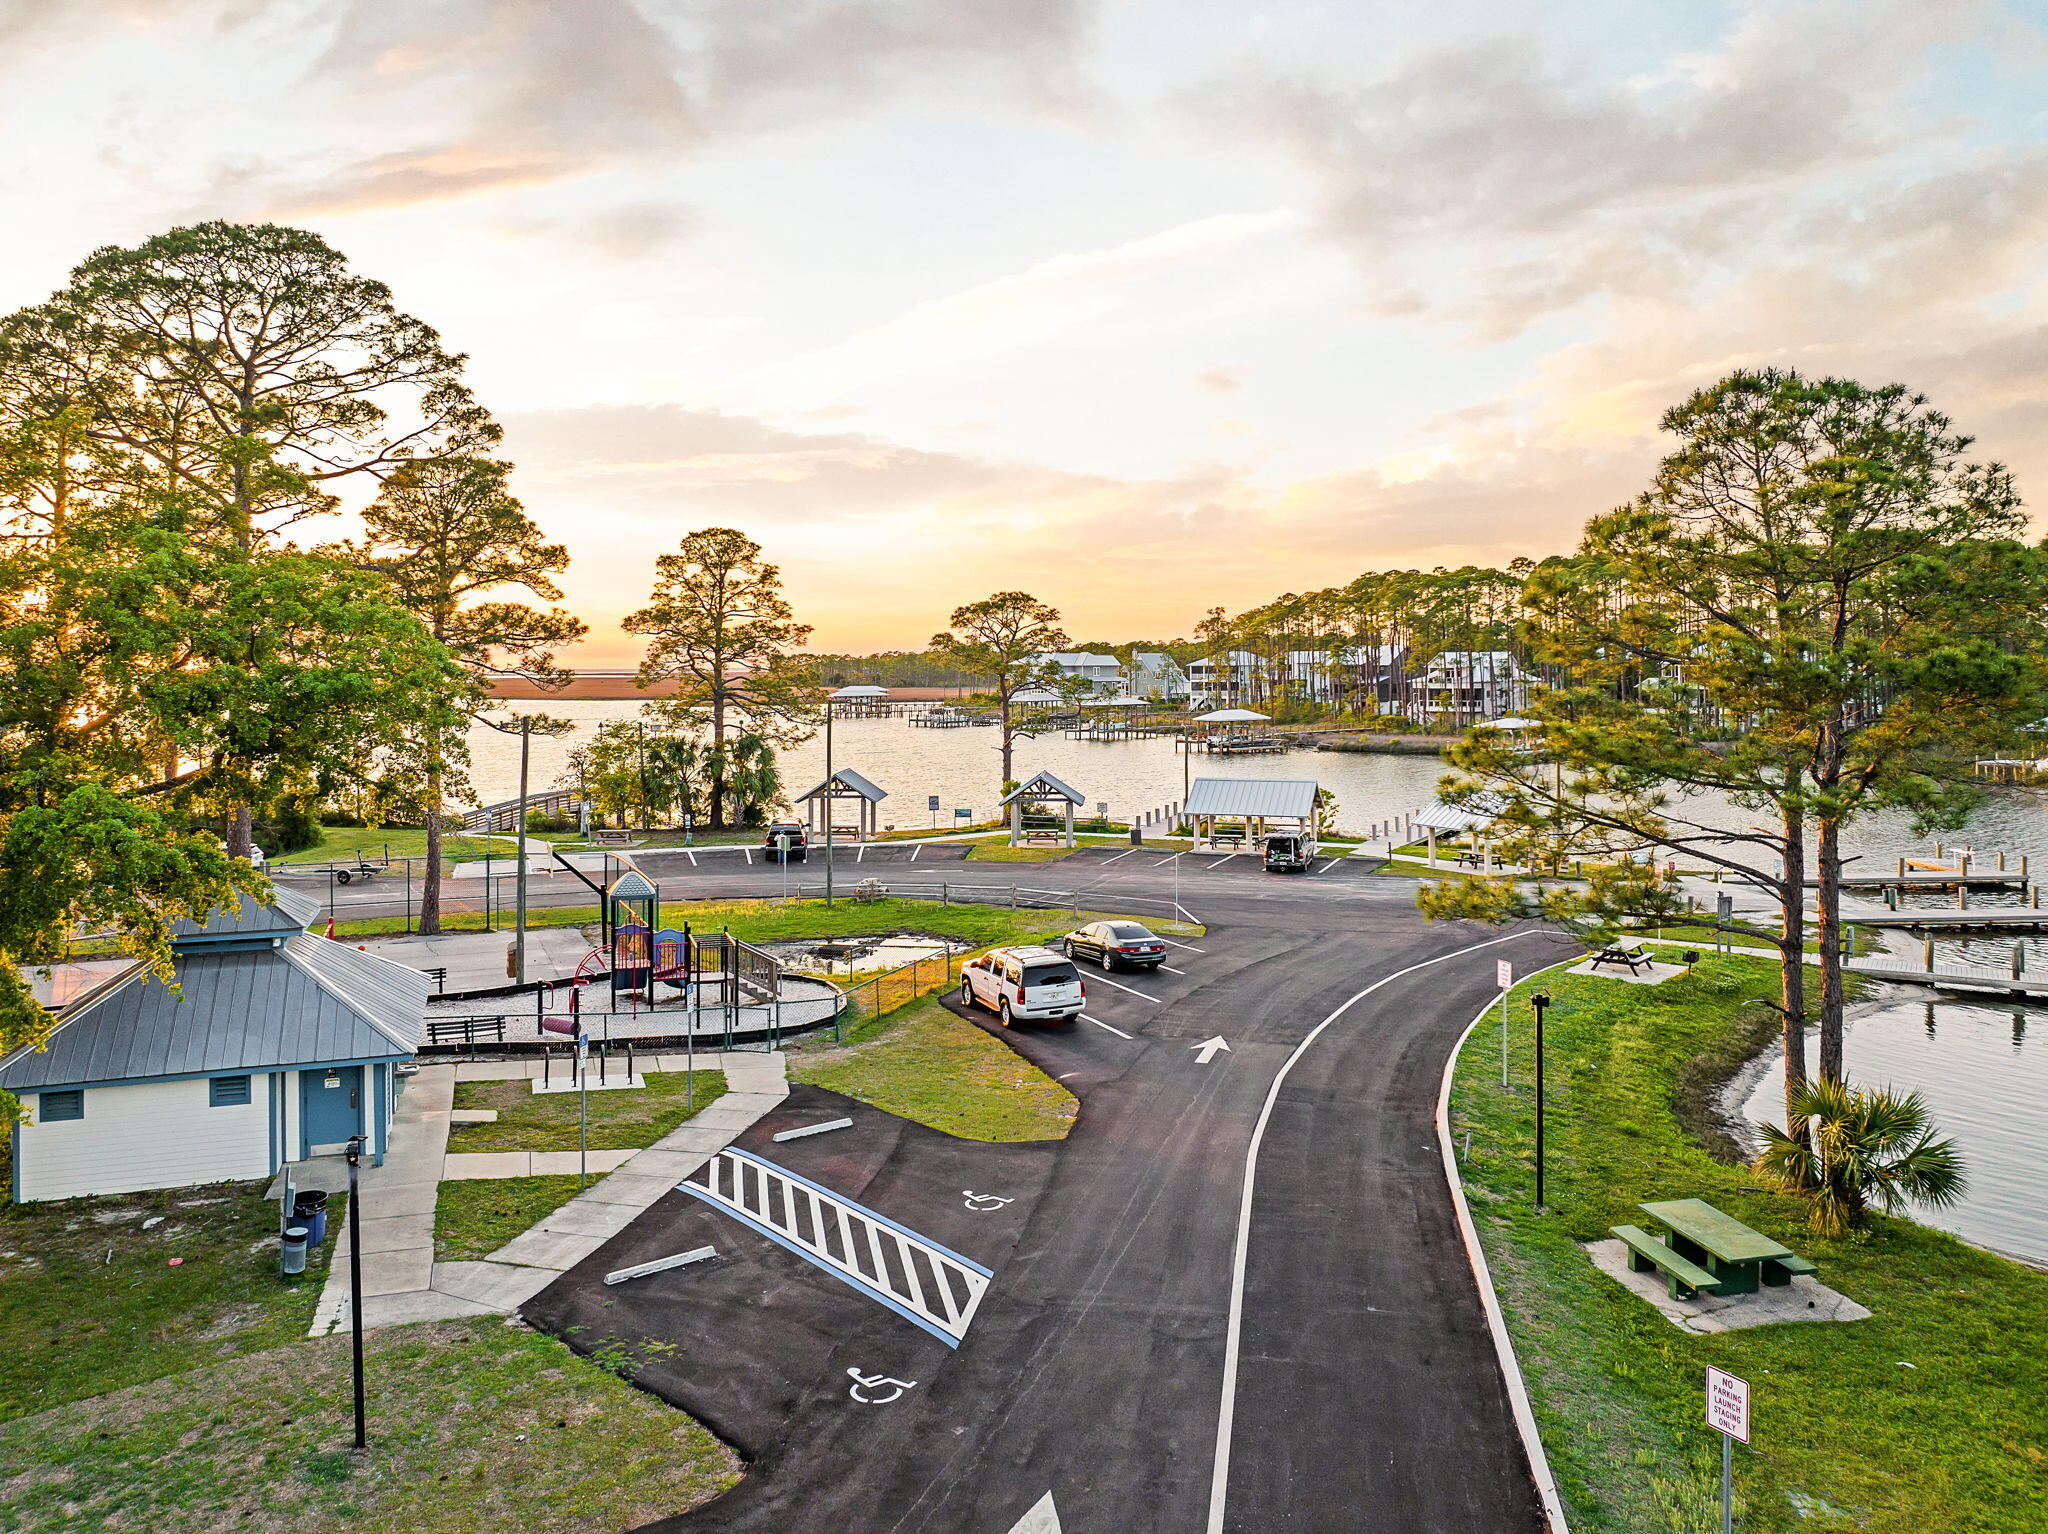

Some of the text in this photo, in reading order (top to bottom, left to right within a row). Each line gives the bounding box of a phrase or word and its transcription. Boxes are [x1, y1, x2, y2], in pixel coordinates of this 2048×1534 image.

[1722, 1377, 1733, 1390] NO
[1713, 1384, 1742, 1404] PARKING
[1714, 1395, 1741, 1414] LAUNCH
[1713, 1405, 1741, 1424] STAGING
[1718, 1417, 1736, 1432] ONLY
